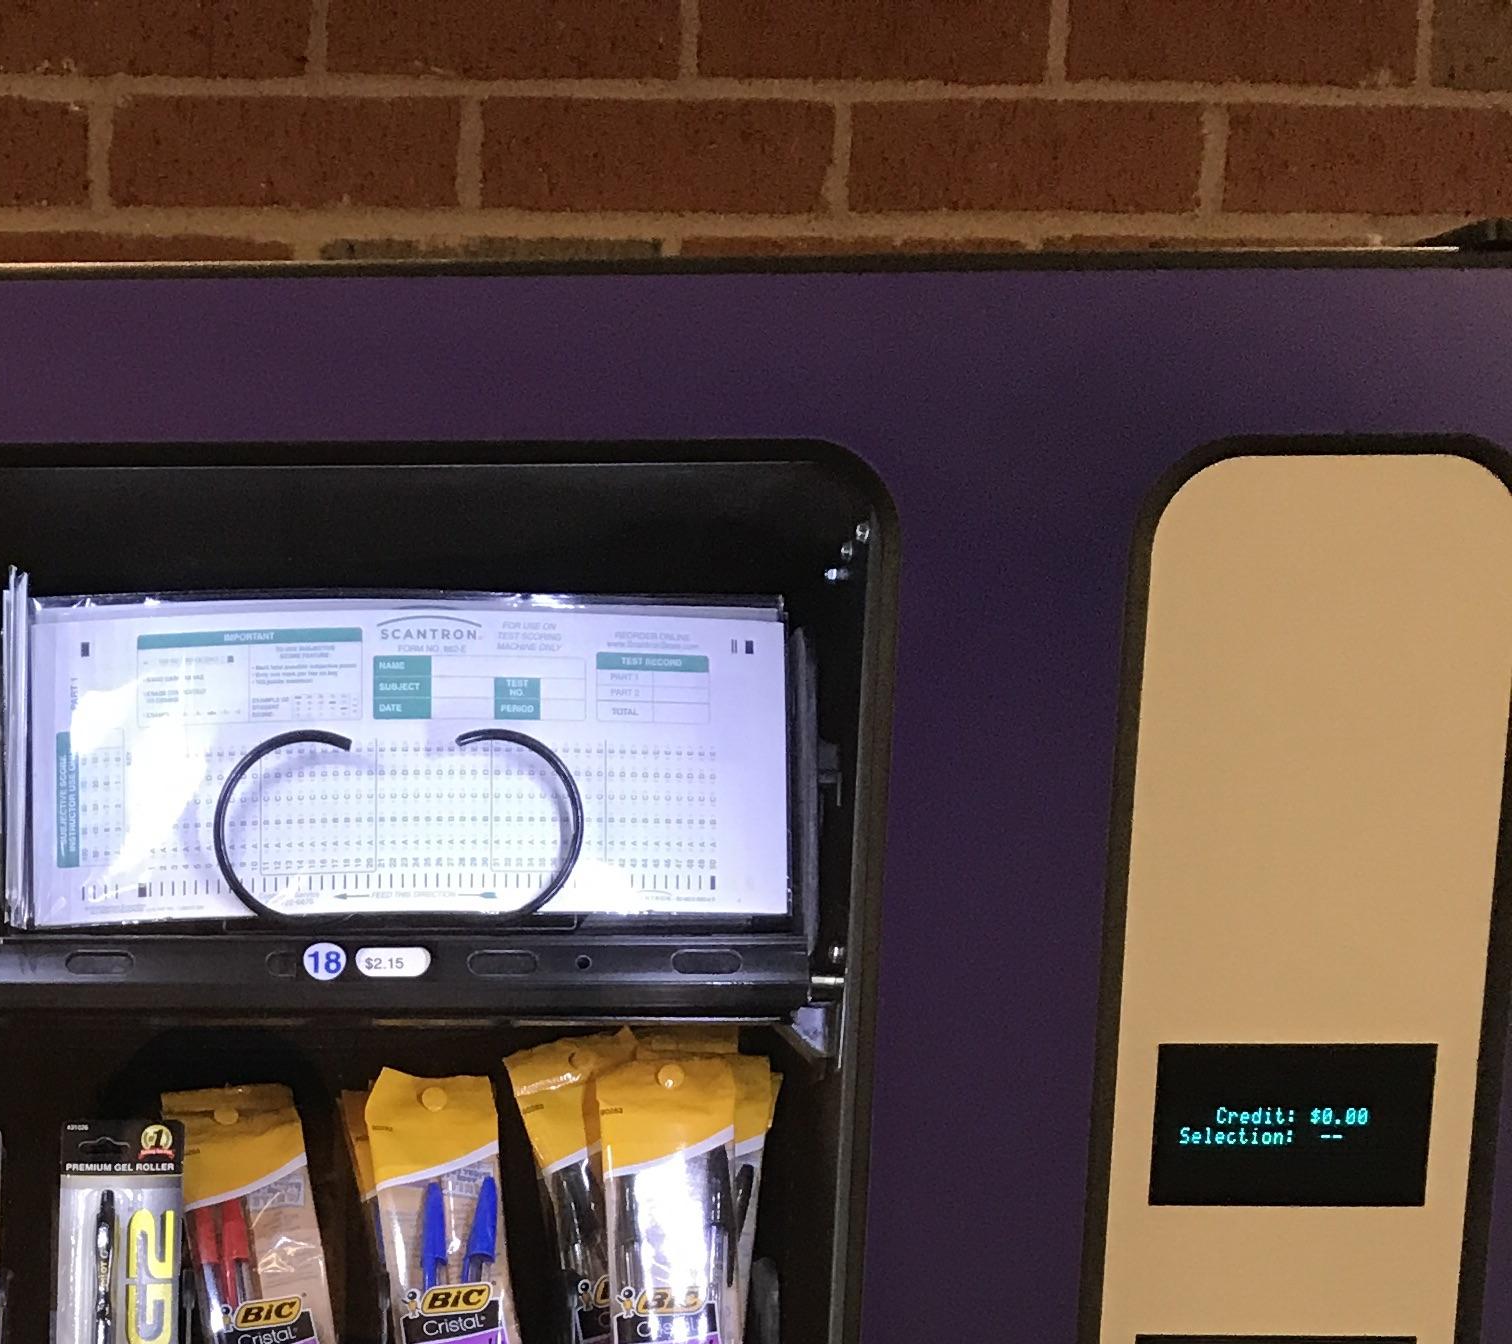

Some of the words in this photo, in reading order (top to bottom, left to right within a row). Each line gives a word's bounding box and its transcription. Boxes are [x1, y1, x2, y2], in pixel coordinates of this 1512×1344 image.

[380, 628, 478, 641] SCANTRON
[379, 660, 405, 671] NAME
[379, 682, 421, 692] SUBJECT
[379, 702, 402, 713] DATE
[307, 951, 342, 975] 18
[364, 956, 404, 970] $2.15
[1216, 1106, 1295, 1125] Credit:
[1310, 1107, 1369, 1126] $0.00
[1179, 1127, 1294, 1145] Selection:
[66, 1163, 112, 1172] PREMIUM
[114, 1163, 134, 1172] GEL
[136, 1162, 174, 1171] ROLLER
[422, 1315, 485, 1337] Cristal
